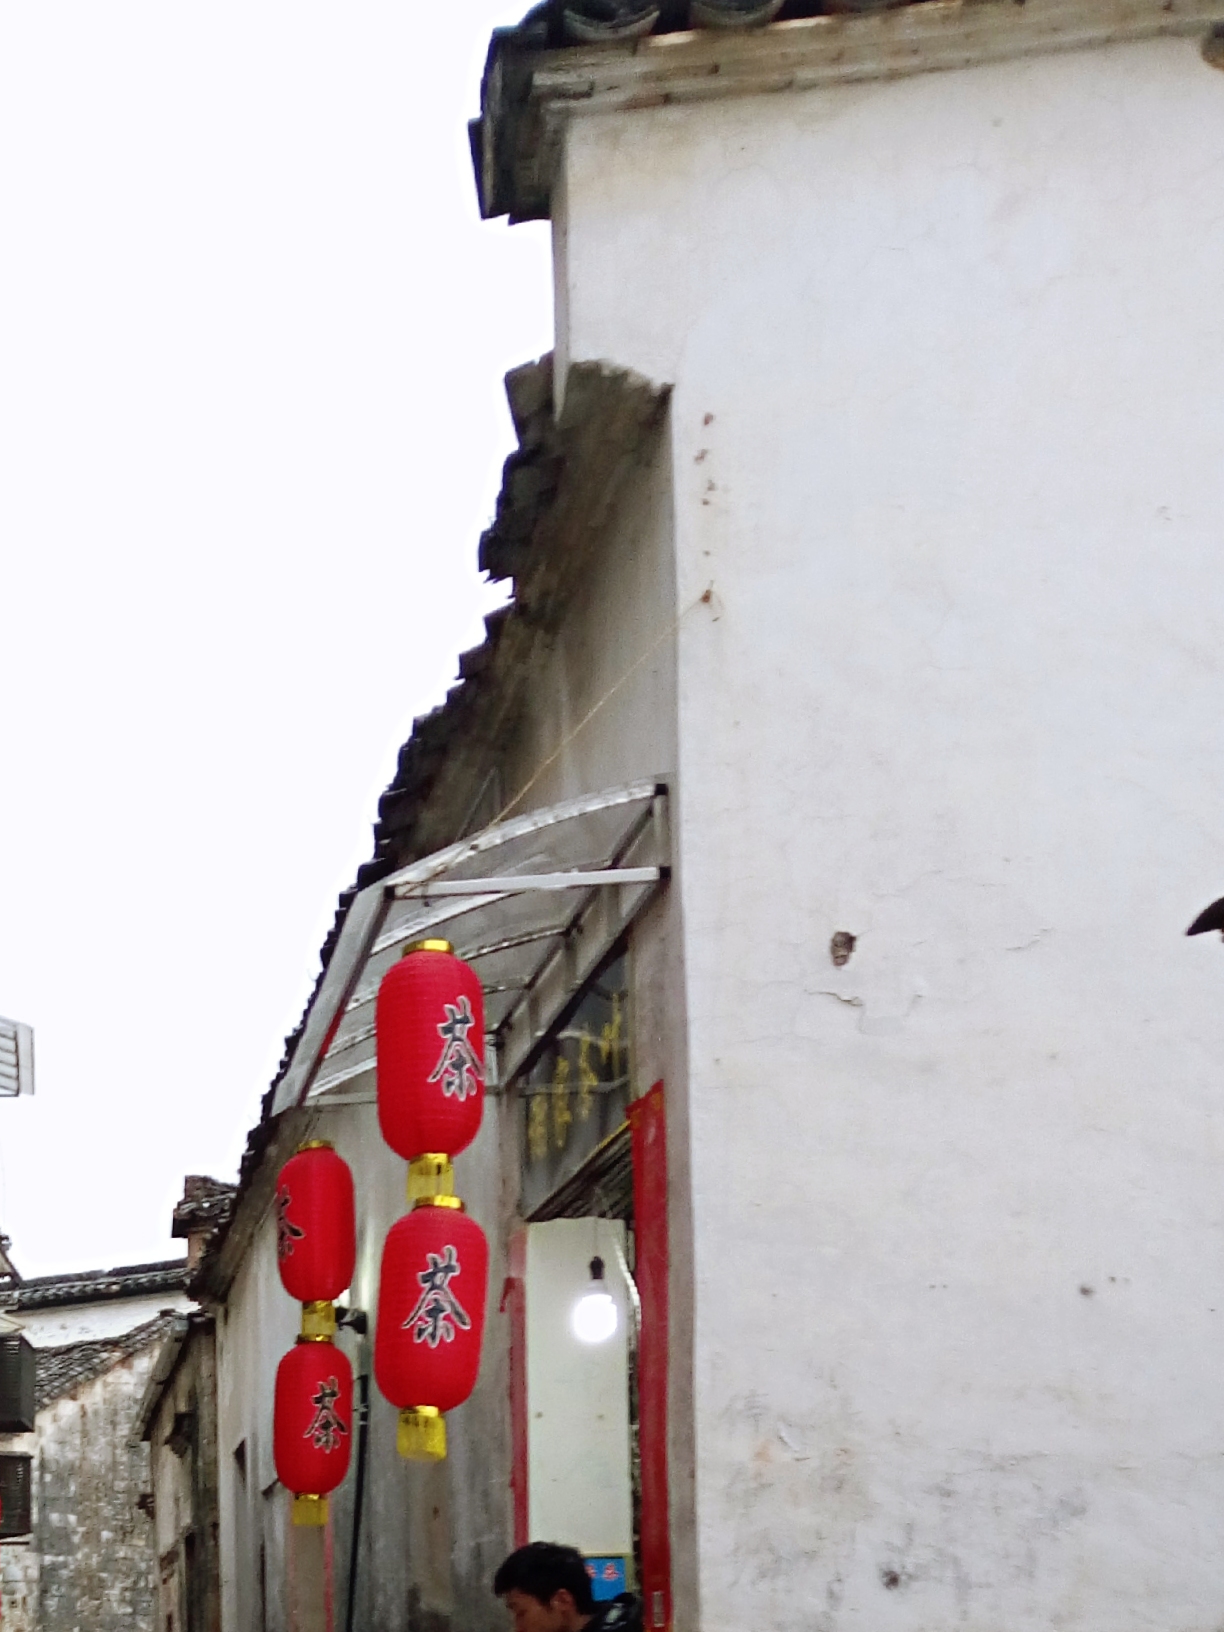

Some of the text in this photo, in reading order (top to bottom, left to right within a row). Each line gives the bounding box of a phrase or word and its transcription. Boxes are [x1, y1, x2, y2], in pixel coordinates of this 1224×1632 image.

[428, 995, 485, 1102] 茶
[402, 1245, 471, 1349] 茶
[303, 1375, 348, 1454] 茶
